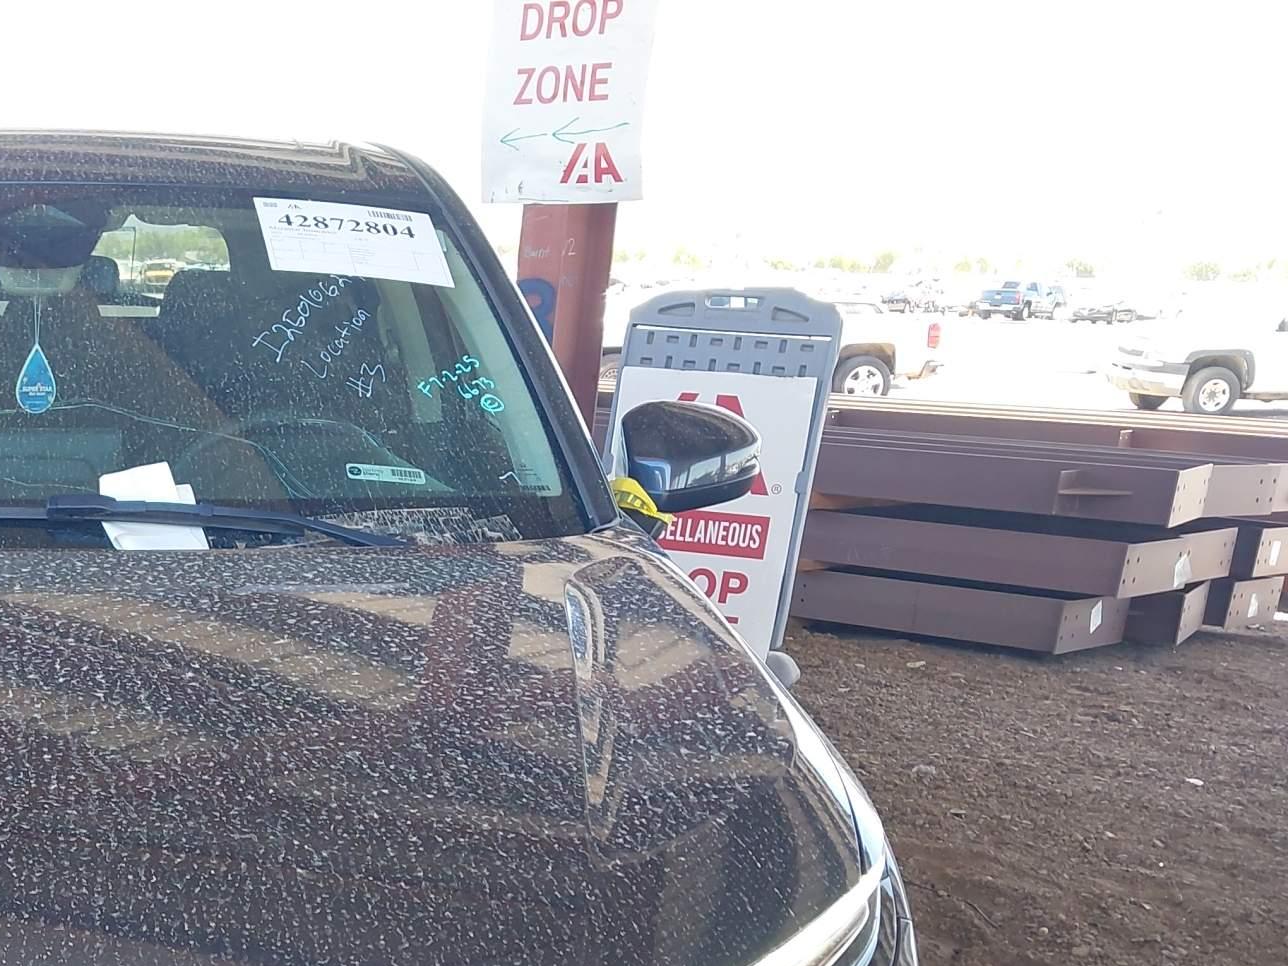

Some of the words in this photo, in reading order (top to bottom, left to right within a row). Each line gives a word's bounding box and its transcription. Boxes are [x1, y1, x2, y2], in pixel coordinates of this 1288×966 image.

[520, 0, 624, 41] DROP
[513, 62, 613, 105] ZONE
[278, 213, 416, 239] 42872804
[346, 362, 386, 398] #3
[659, 516, 762, 549] ELLANEOUS
